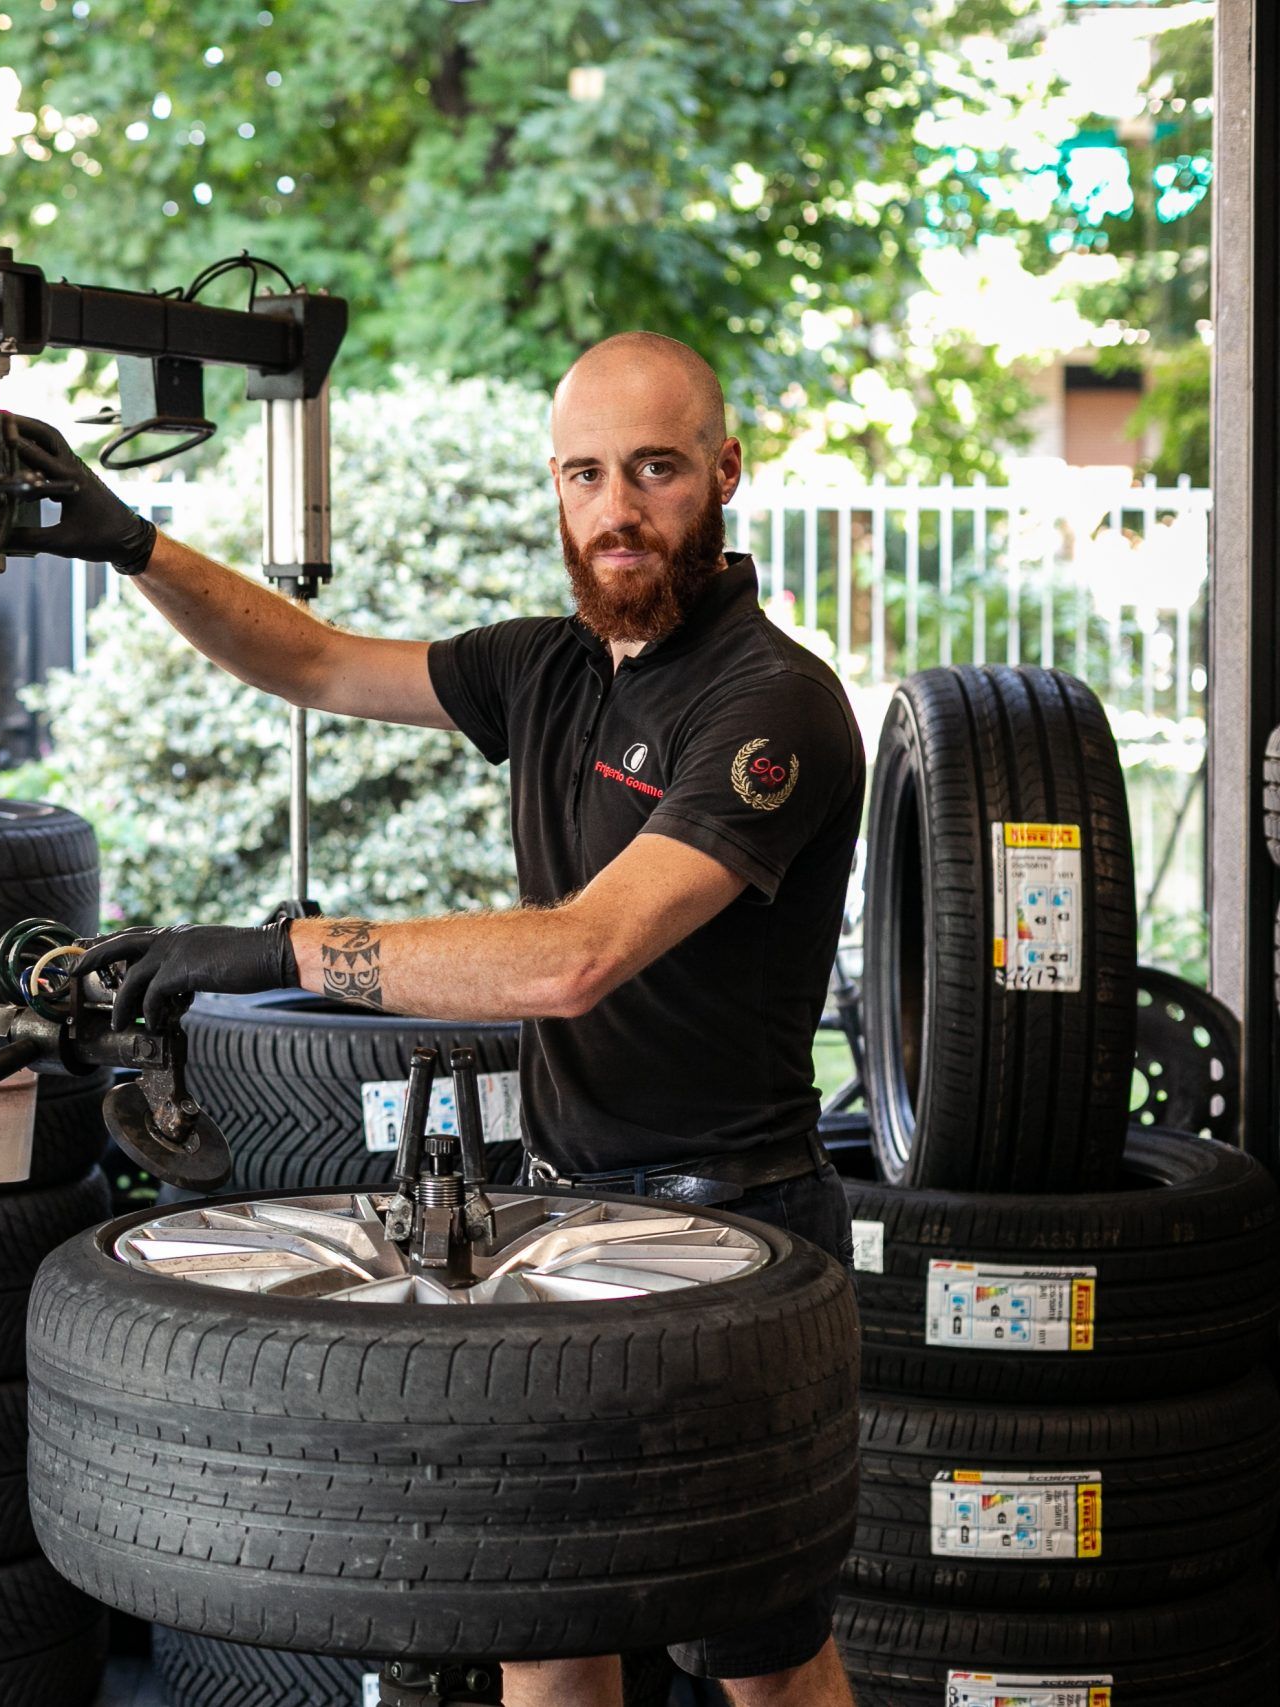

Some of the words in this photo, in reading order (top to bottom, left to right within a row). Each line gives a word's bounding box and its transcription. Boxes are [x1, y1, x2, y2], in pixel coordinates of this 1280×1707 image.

[594, 761, 624, 783] Frigerio
[625, 775, 664, 799] Gomme
[750, 757, 786, 782] 90
[1075, 1285, 1091, 1344] PIRELLI
[1082, 1490, 1097, 1551] PIRELLI
